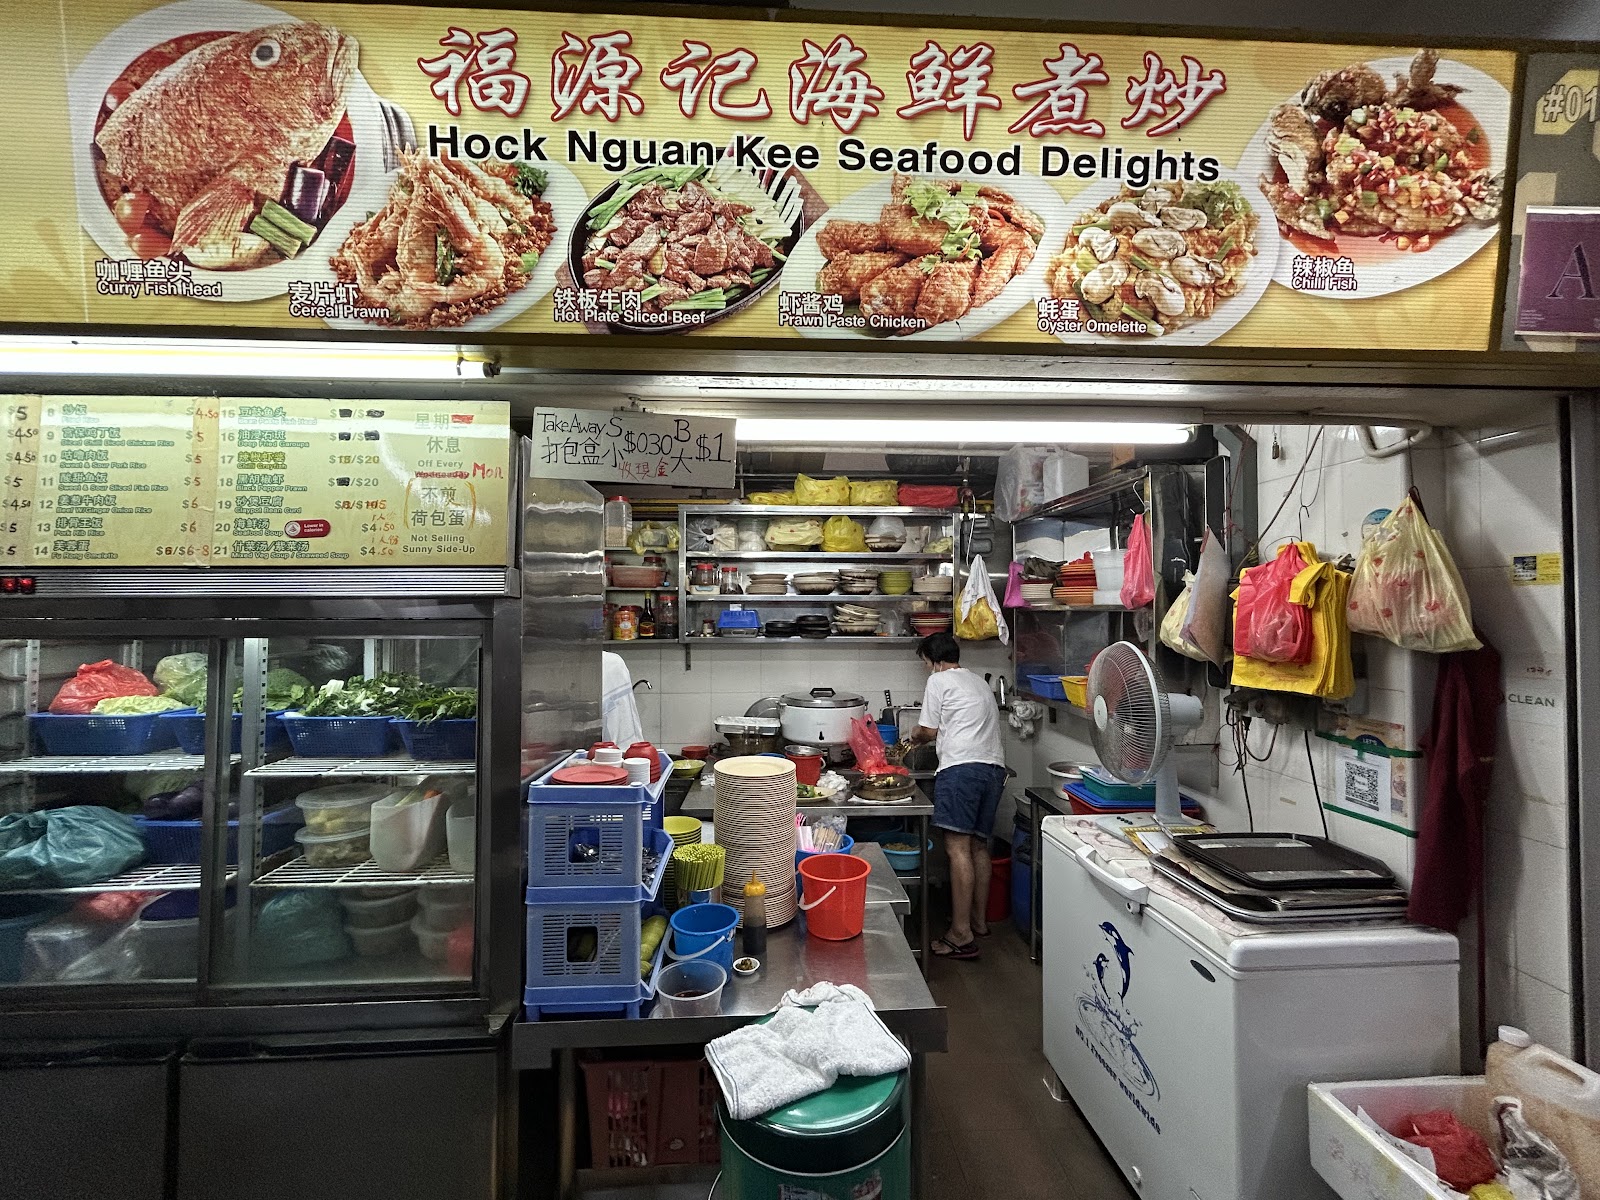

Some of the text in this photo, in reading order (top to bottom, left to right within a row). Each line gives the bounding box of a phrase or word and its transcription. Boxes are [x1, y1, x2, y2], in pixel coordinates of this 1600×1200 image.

[418, 27, 1226, 140] 福源记海鲜煮炒
[429, 126, 1219, 187] Hock Nguan Kee Seafood Delights
[95, 259, 191, 283] 咖喱鱼头
[1292, 256, 1355, 277] 辣椒鱼
[97, 282, 222, 297] Curry Fish Head
[1292, 277, 1357, 291] Chilli Fish
[288, 281, 358, 305] 麦片虾
[554, 289, 641, 310] 铁板牛肉
[779, 292, 844, 316] 虾酱鸡
[289, 304, 390, 318] Cereal Prawn
[1038, 298, 1080, 321] 蚝蛋
[554, 309, 706, 324] Hot Plate Sliced Beef
[779, 314, 926, 329] Prawn Paste Chicken
[1038, 319, 1147, 334] Oyster Omelette
[221, 410, 235, 418] 15
[47, 432, 54, 440] 9
[221, 433, 235, 441] 16
[426, 437, 461, 453] 休息
[42, 454, 57, 463] 10
[220, 455, 234, 464] 17
[436, 460, 463, 469] Every
[41, 477, 54, 486] 11
[219, 478, 233, 486] 18
[237, 474, 284, 485] 黑胡椒虾
[39, 500, 53, 509] 12
[218, 500, 232, 509] 19
[56, 517, 103, 528] 排骨王饭
[234, 518, 270, 529] 海鲜汤
[411, 510, 465, 526] 荷包蛋
[37, 523, 51, 532] 13
[215, 523, 231, 532] 20
[431, 535, 465, 543] Selling
[34, 546, 48, 555] 14
[214, 546, 227, 555] 21
[402, 545, 475, 554] Sunny Side-Up
[1508, 694, 1554, 707] CLEAN
